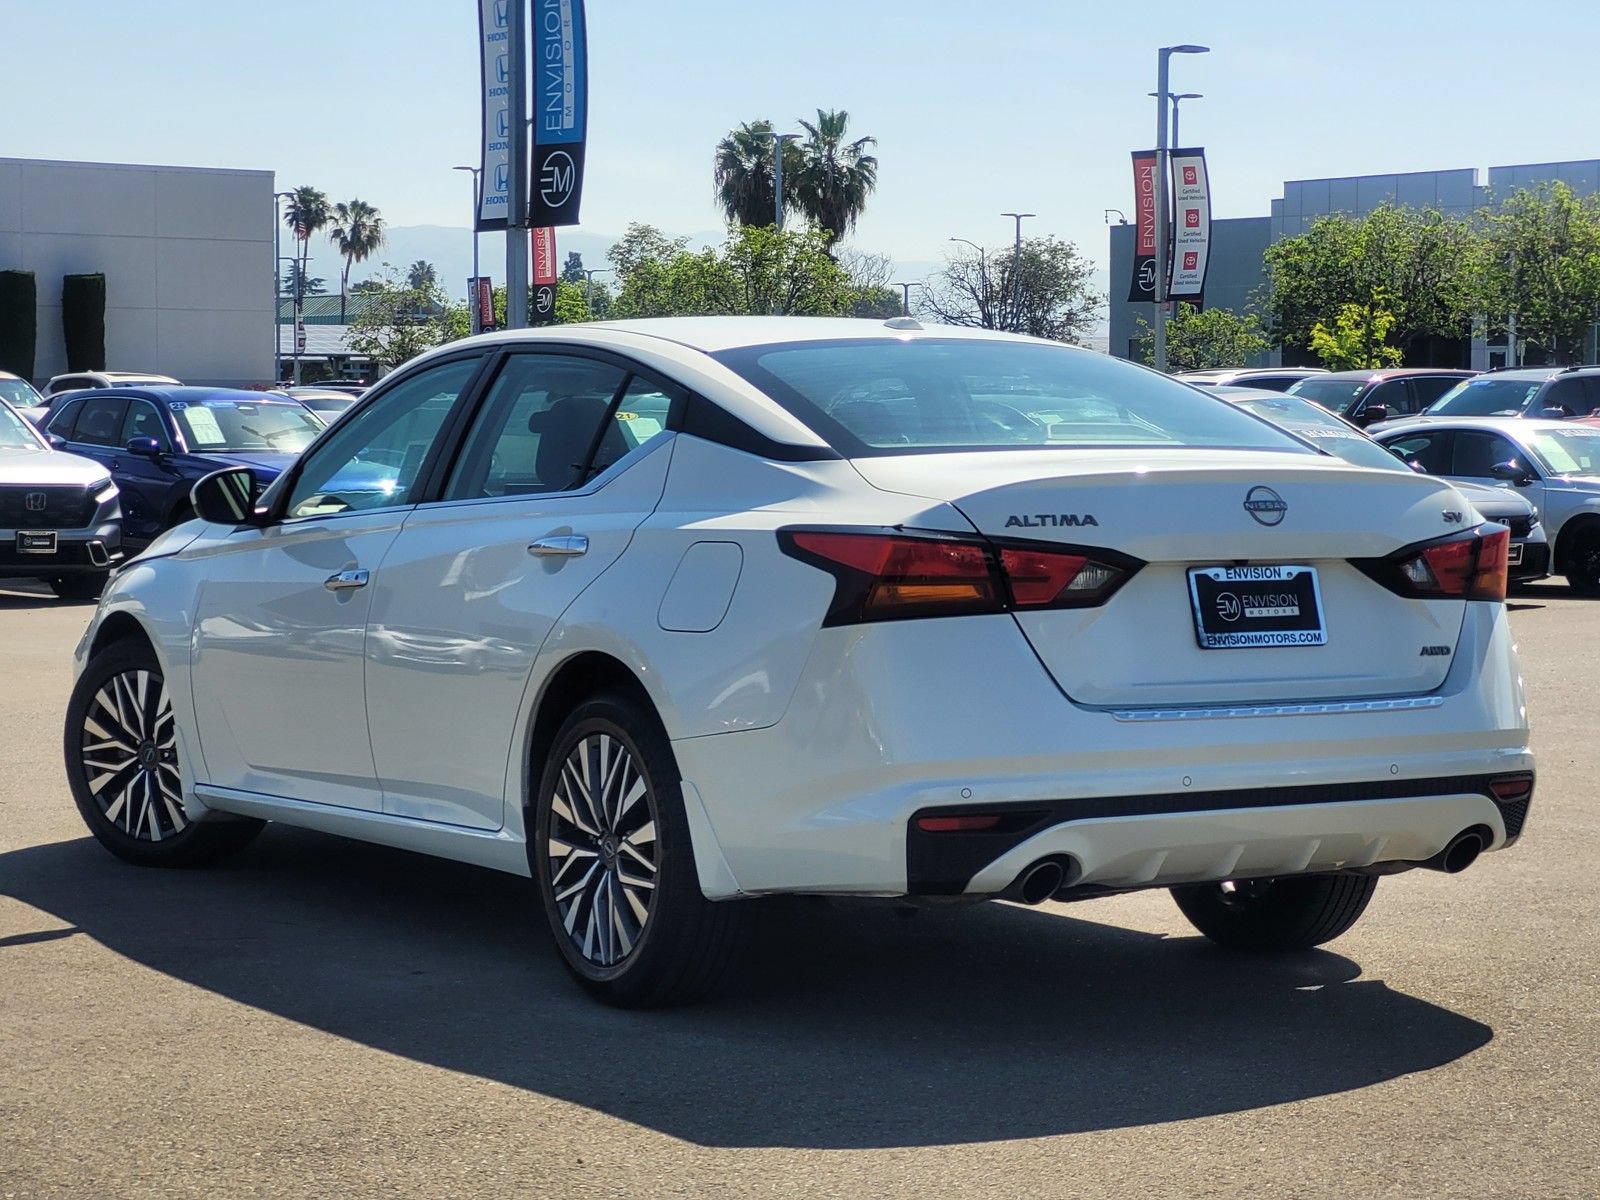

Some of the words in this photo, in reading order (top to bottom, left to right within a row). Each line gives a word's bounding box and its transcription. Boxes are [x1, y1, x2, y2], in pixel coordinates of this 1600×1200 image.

[487, 33, 508, 42] HON
[489, 88, 508, 97] HON
[488, 143, 508, 151] HON
[485, 196, 508, 205] HON
[1142, 167, 1155, 248] ENVISION
[537, 228, 546, 278] ENVISIO
[1244, 499, 1288, 512] NISSAN
[1005, 513, 1099, 528] ALTIMA
[1443, 510, 1463, 524] SV
[1226, 567, 1281, 579] ENVISION
[1242, 593, 1298, 608] ENVISION
[1207, 633, 1323, 646] ENVISIONMOTORS.COM
[1420, 644, 1451, 657] AWD
